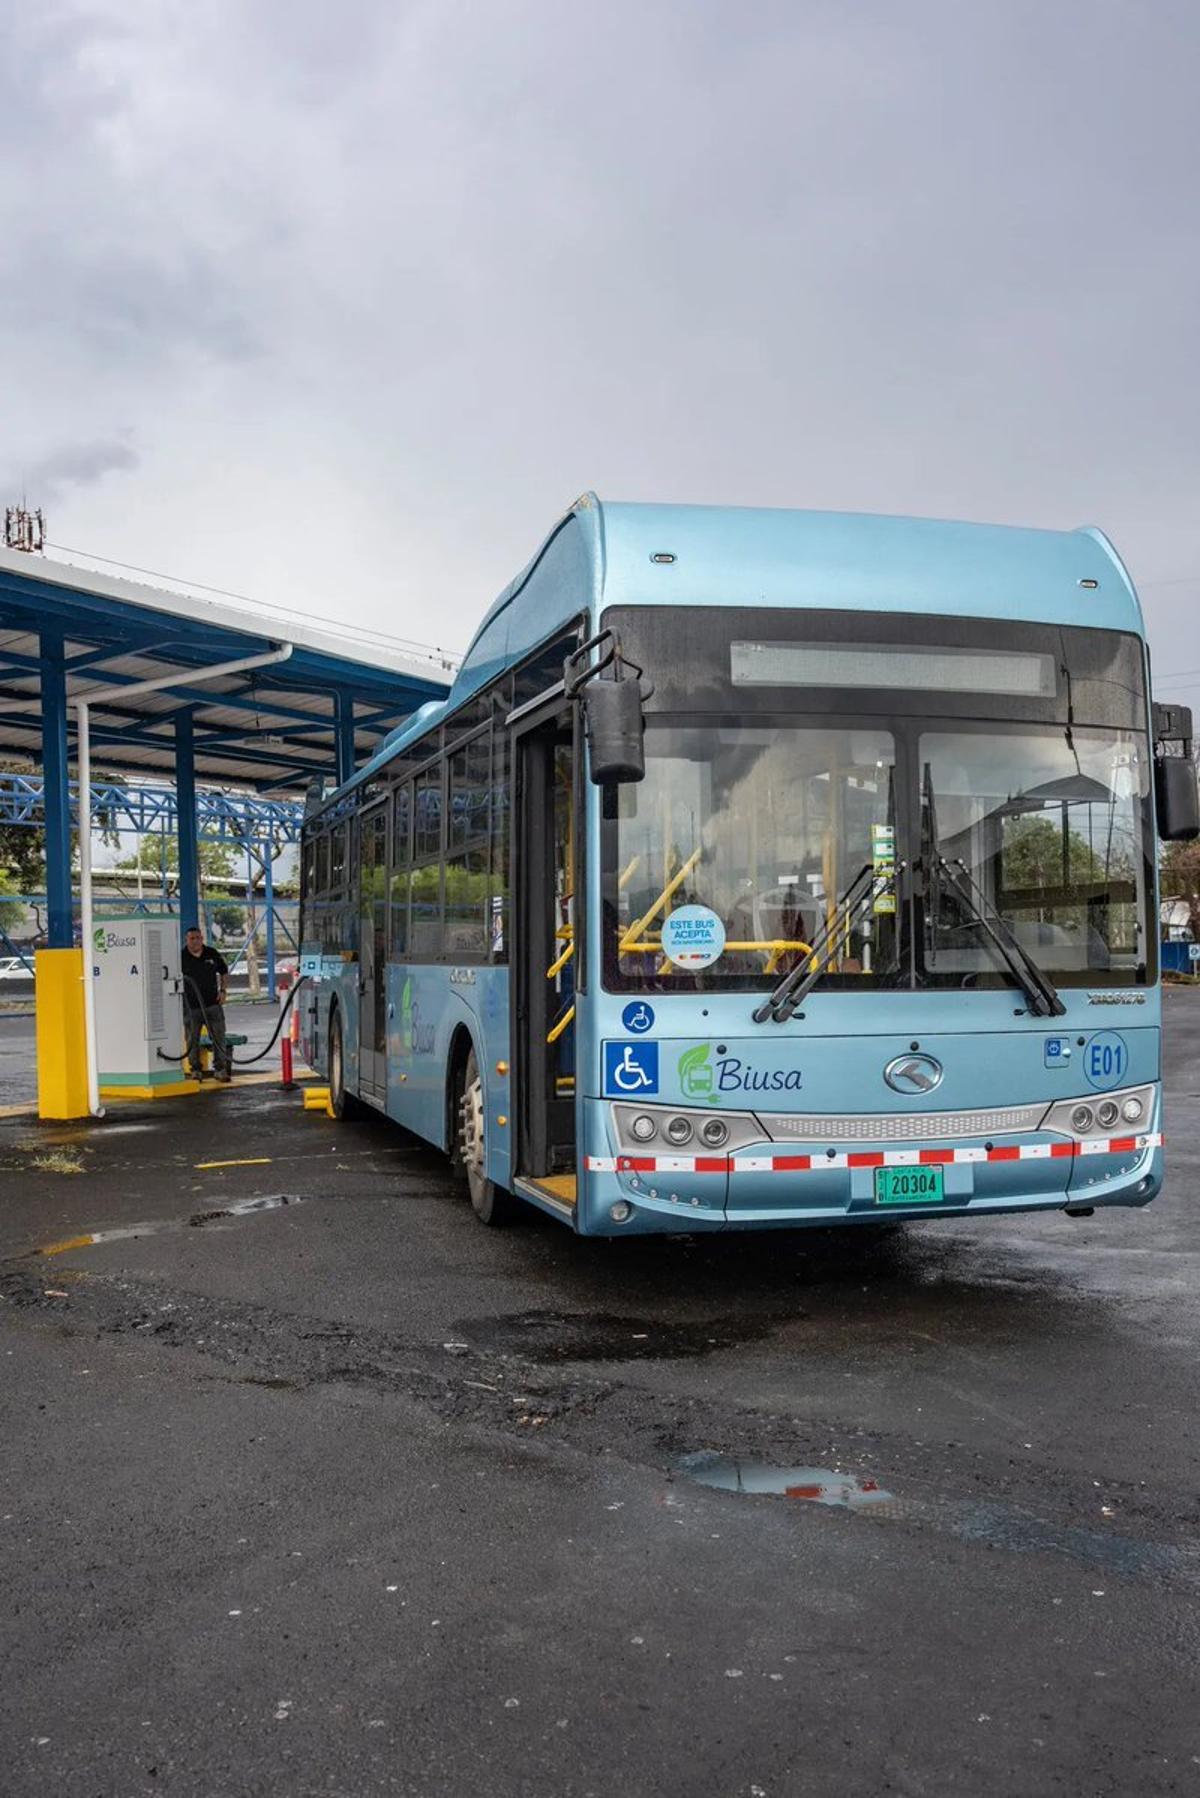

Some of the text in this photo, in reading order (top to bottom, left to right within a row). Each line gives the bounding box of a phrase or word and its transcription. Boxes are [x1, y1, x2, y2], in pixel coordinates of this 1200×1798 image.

[670, 919, 715, 929] ESTE BUS
[106, 932, 136, 948] Biusa
[674, 930, 711, 939] ACEPTA
[93, 966, 100, 976] B
[130, 965, 139, 976] A
[1091, 1045, 1121, 1076] E01
[716, 1058, 803, 1091] Biusa
[892, 1174, 936, 1195] 20304
